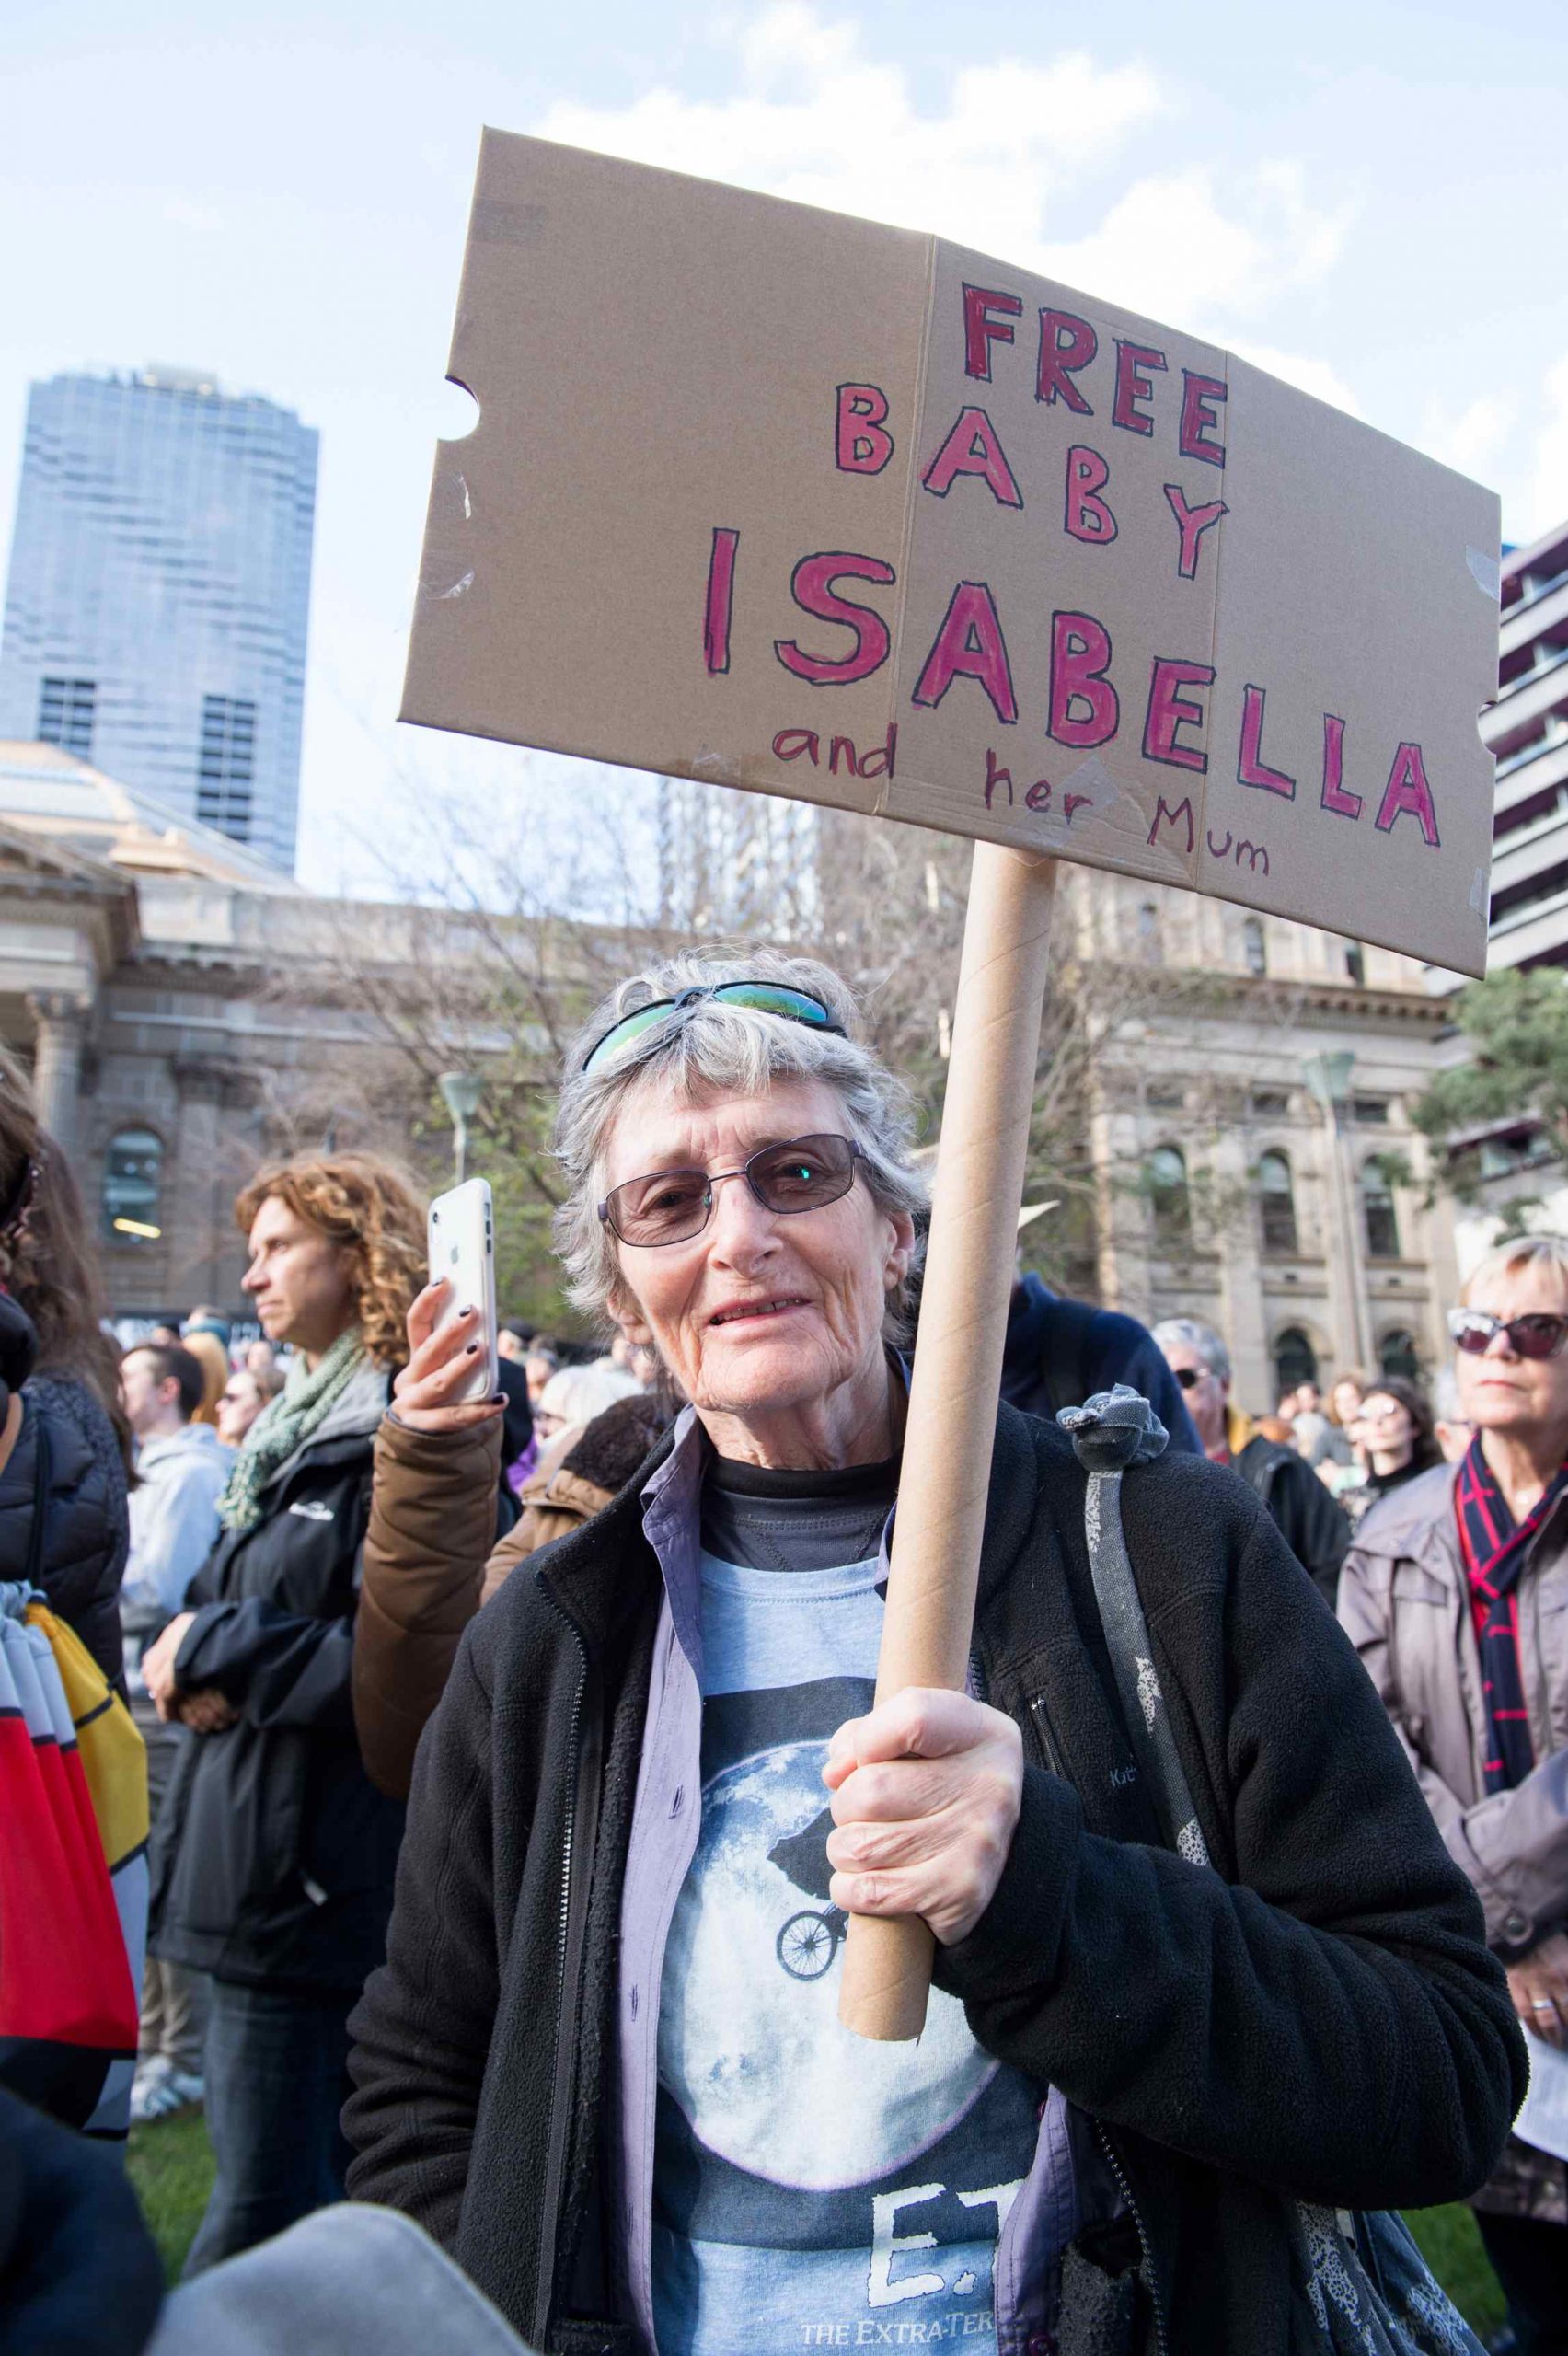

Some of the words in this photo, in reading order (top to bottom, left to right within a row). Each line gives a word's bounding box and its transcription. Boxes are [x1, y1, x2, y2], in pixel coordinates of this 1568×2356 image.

[962, 282, 1228, 469] FREE
[835, 382, 1230, 581] BABY
[703, 527, 1441, 848] ISABELLA
[772, 722, 898, 780] and
[984, 747, 1093, 826] her
[1147, 795, 1272, 877] Mum
[801, 2324, 850, 2345] THE
